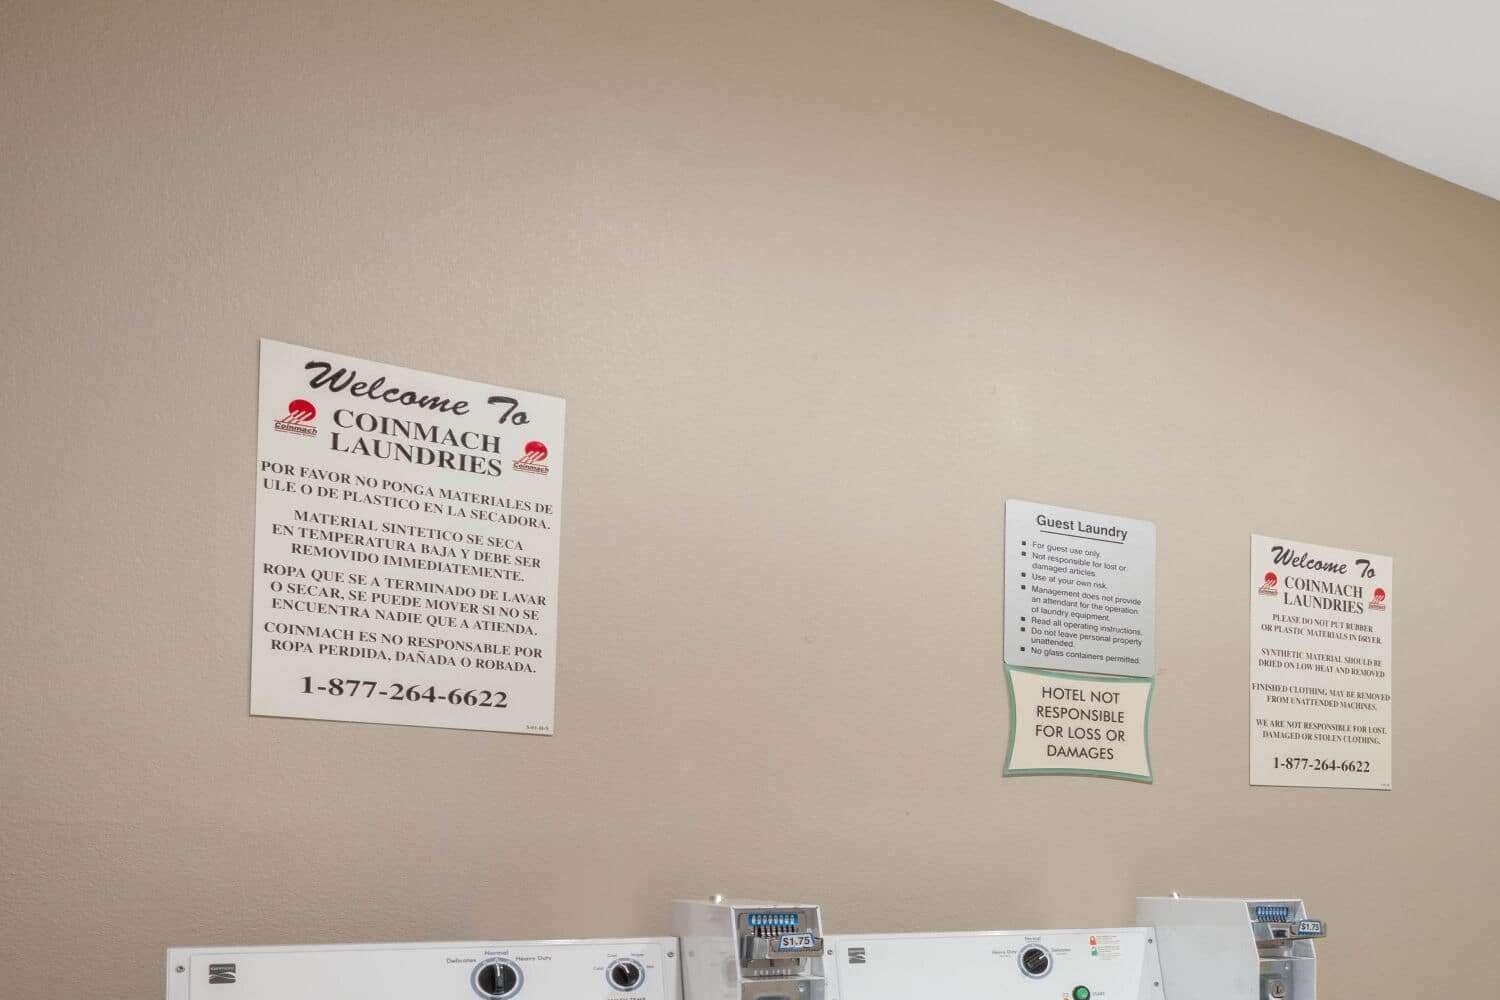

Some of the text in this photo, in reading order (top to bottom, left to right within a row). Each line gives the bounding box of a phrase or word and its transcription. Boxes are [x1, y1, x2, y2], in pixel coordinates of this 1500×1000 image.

[305, 361, 530, 425] Welcome To
[274, 420, 317, 437] Coinmach
[333, 409, 500, 454] COINMACH
[331, 432, 501, 476] LAUNDRIES
[262, 461, 552, 514] POR FAVOR NO PONGA MATERIALES DE
[264, 478, 550, 529] ULE O DE PLASTICO EN LA SECADORA.
[295, 510, 523, 550] MATERIAL SINTETICO SE SECA
[1036, 514, 1128, 541] Guest Laundry
[273, 524, 540, 568] EN TEMPERATURA BAJA Y DEBE SER
[292, 543, 524, 581] REMOVIDO IMMEDIATEMENTE.
[1032, 552, 1046, 560] Not
[1047, 556, 1091, 567] responsible
[1271, 546, 1376, 578] Welcome To
[264, 563, 546, 606] ROPA QUE SE A TERMINADO DE LAVAR
[1032, 573, 1047, 582] Use
[1284, 576, 1363, 599] COINMACH
[270, 582, 539, 620] O SECAR, SE PUEDE MOVER SI NO SE
[1032, 585, 1080, 598] Management
[1081, 592, 1100, 600] does
[1115, 597, 1142, 606] provide
[1284, 592, 1364, 614] LAUNDRIES
[272, 598, 537, 635] ENCUENTRA NADIE QUE A ATIENDA.
[1040, 607, 1069, 618] laundry
[1272, 614, 1300, 624] PLEASE
[1314, 618, 1328, 627] NOT
[1330, 620, 1344, 629] PUT
[1346, 623, 1373, 632] RUBBER
[1031, 616, 1051, 626] Read
[1063, 622, 1099, 632] operating
[264, 622, 542, 658] COINMACH ES NO RESPONSABLE POR
[1031, 627, 1142, 647] Do not leave personal property
[272, 639, 536, 673] ROPA PERDIDA, DAÑADA O ROBADA.
[1031, 647, 1042, 655] No
[1065, 652, 1104, 660] containers
[1261, 648, 1302, 658] SYNTHETIC
[1306, 652, 1342, 663] MATERIAL
[1344, 657, 1372, 666] SHOULD
[303, 676, 507, 708] 1-877-264-6622
[1042, 687, 1120, 704] HOTEL NOT
[1037, 705, 1124, 723] RESPONSIBLE
[1036, 724, 1125, 742] FOR LOSS OR
[1304, 722, 1350, 732] RESPONSIBLE
[1047, 744, 1114, 760] DAMAGES
[1274, 757, 1370, 773] 1-877-264-6622
[1301, 922, 1320, 930] $1.75
[783, 937, 810, 946] $1.75
